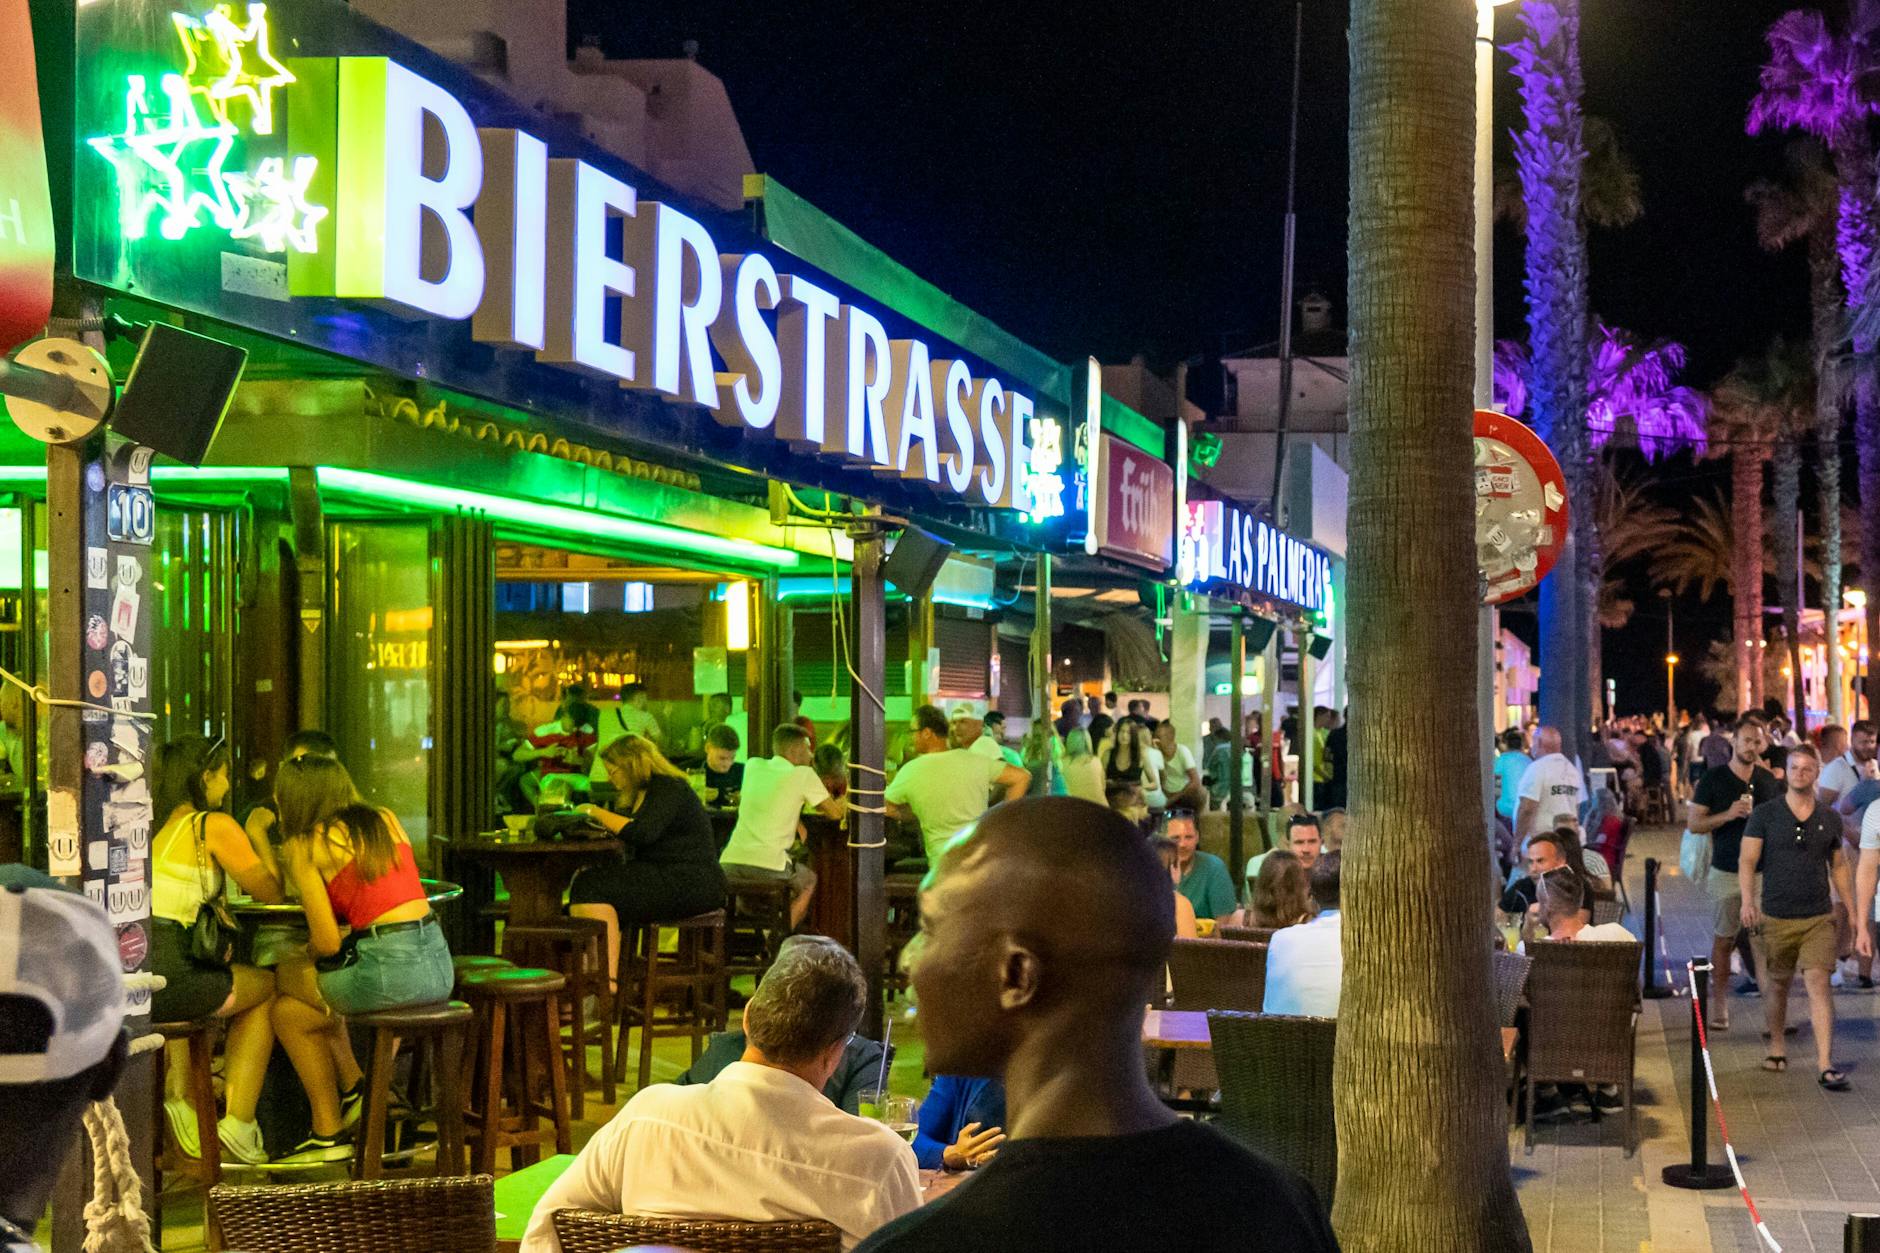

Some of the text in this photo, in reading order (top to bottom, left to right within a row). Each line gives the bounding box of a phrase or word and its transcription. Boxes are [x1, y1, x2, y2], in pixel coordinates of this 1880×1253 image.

[384, 56, 1035, 514] BIERSTRASSE
[118, 490, 149, 537] 10
[1217, 501, 1254, 589] LAS
